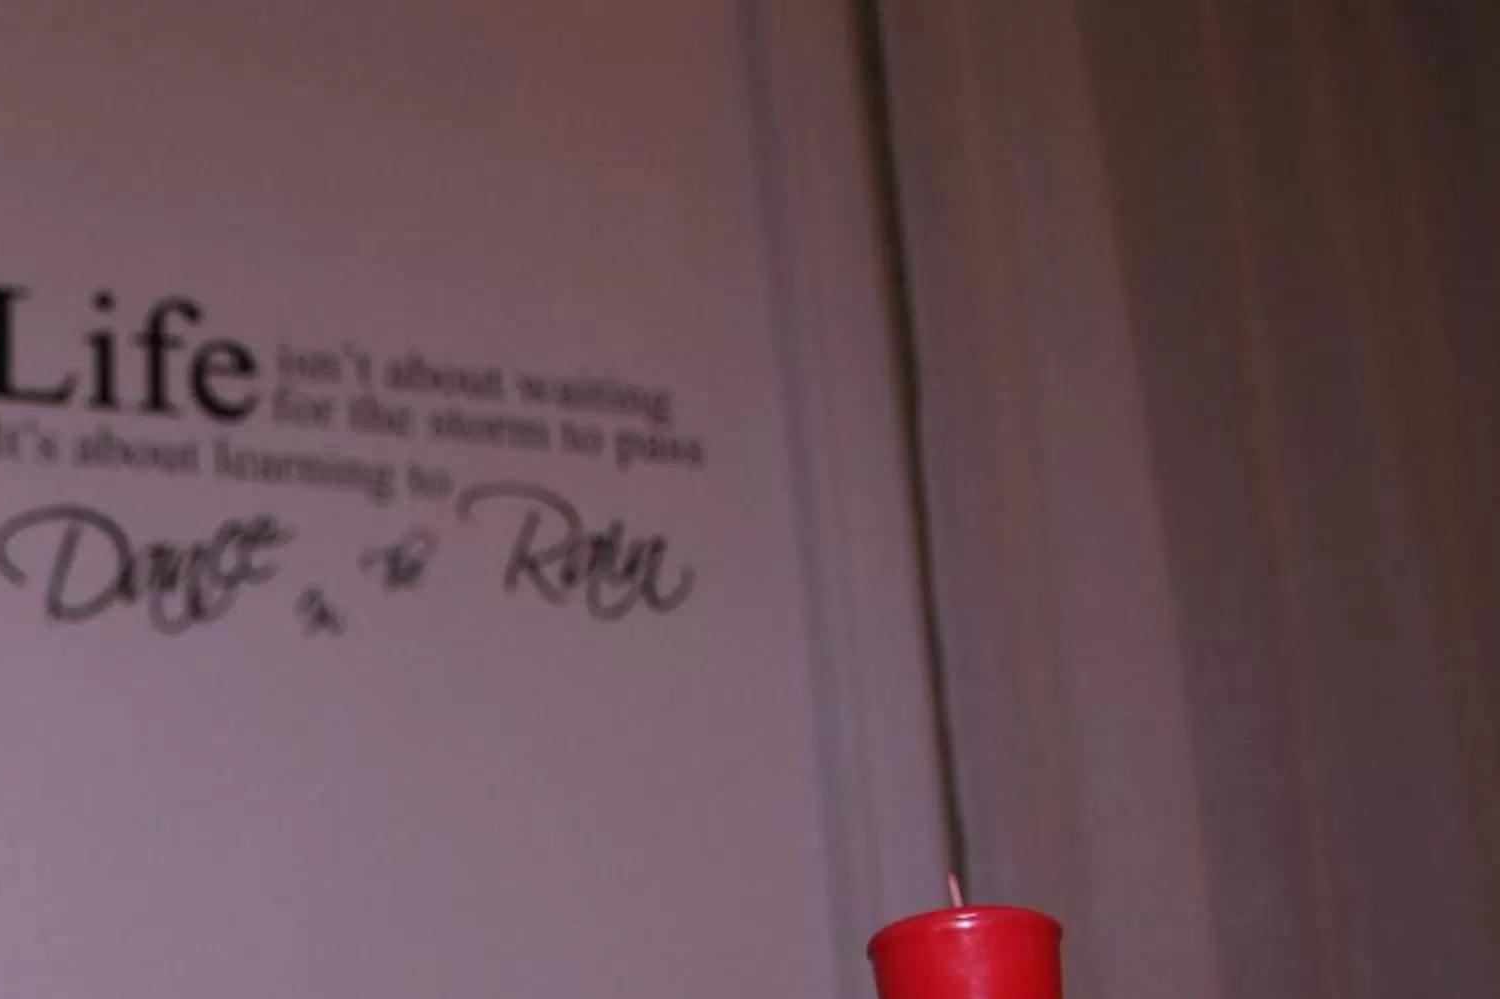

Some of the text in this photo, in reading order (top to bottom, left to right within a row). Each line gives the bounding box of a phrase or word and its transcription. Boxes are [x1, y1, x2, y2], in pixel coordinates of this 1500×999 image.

[275, 343, 373, 386] isn't
[384, 350, 503, 398] about
[515, 366, 674, 425] waiting
[71, 421, 199, 475] about
[213, 436, 398, 506] learning
[406, 462, 454, 498] to
[272, 387, 706, 471] for the storm to pass
